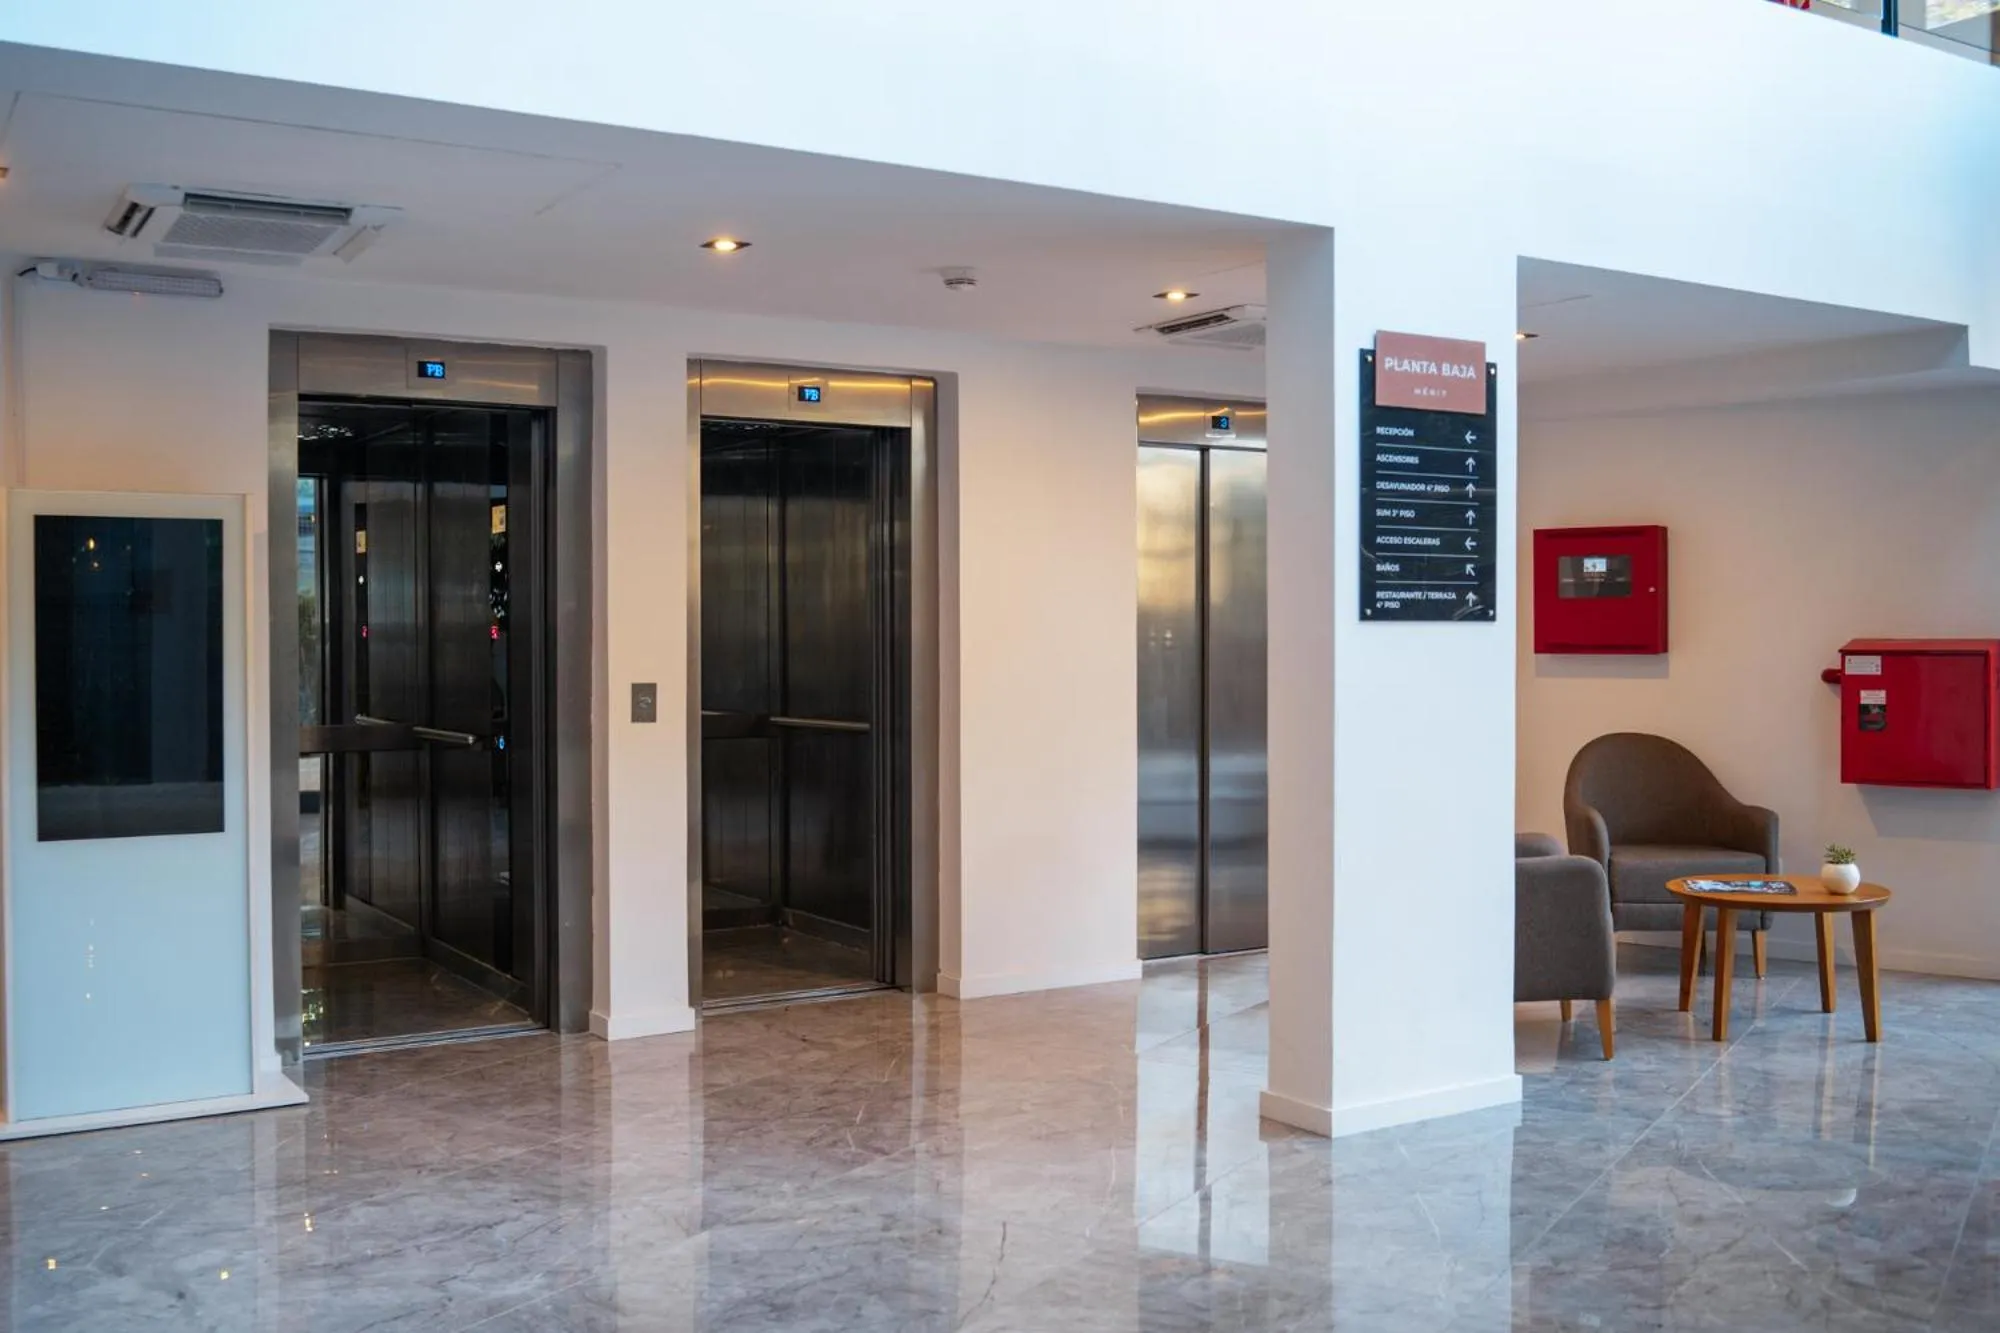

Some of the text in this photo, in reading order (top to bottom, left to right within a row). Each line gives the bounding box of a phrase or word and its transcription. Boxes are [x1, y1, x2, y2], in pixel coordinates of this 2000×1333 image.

[426, 363, 444, 377] PB
[1384, 357, 1476, 379] PLANTA BAJA
[804, 388, 819, 401] PB
[1376, 426, 1414, 437] RECEPCIÓN
[1376, 454, 1419, 464] ASCENSORES
[1433, 484, 1450, 492] PISO
[1399, 509, 1416, 518] PISO
[1376, 536, 1440, 546] ACCESO ESCALERAS
[1376, 563, 1400, 572] BAÑOS
[1427, 592, 1457, 600] TERRAZA
